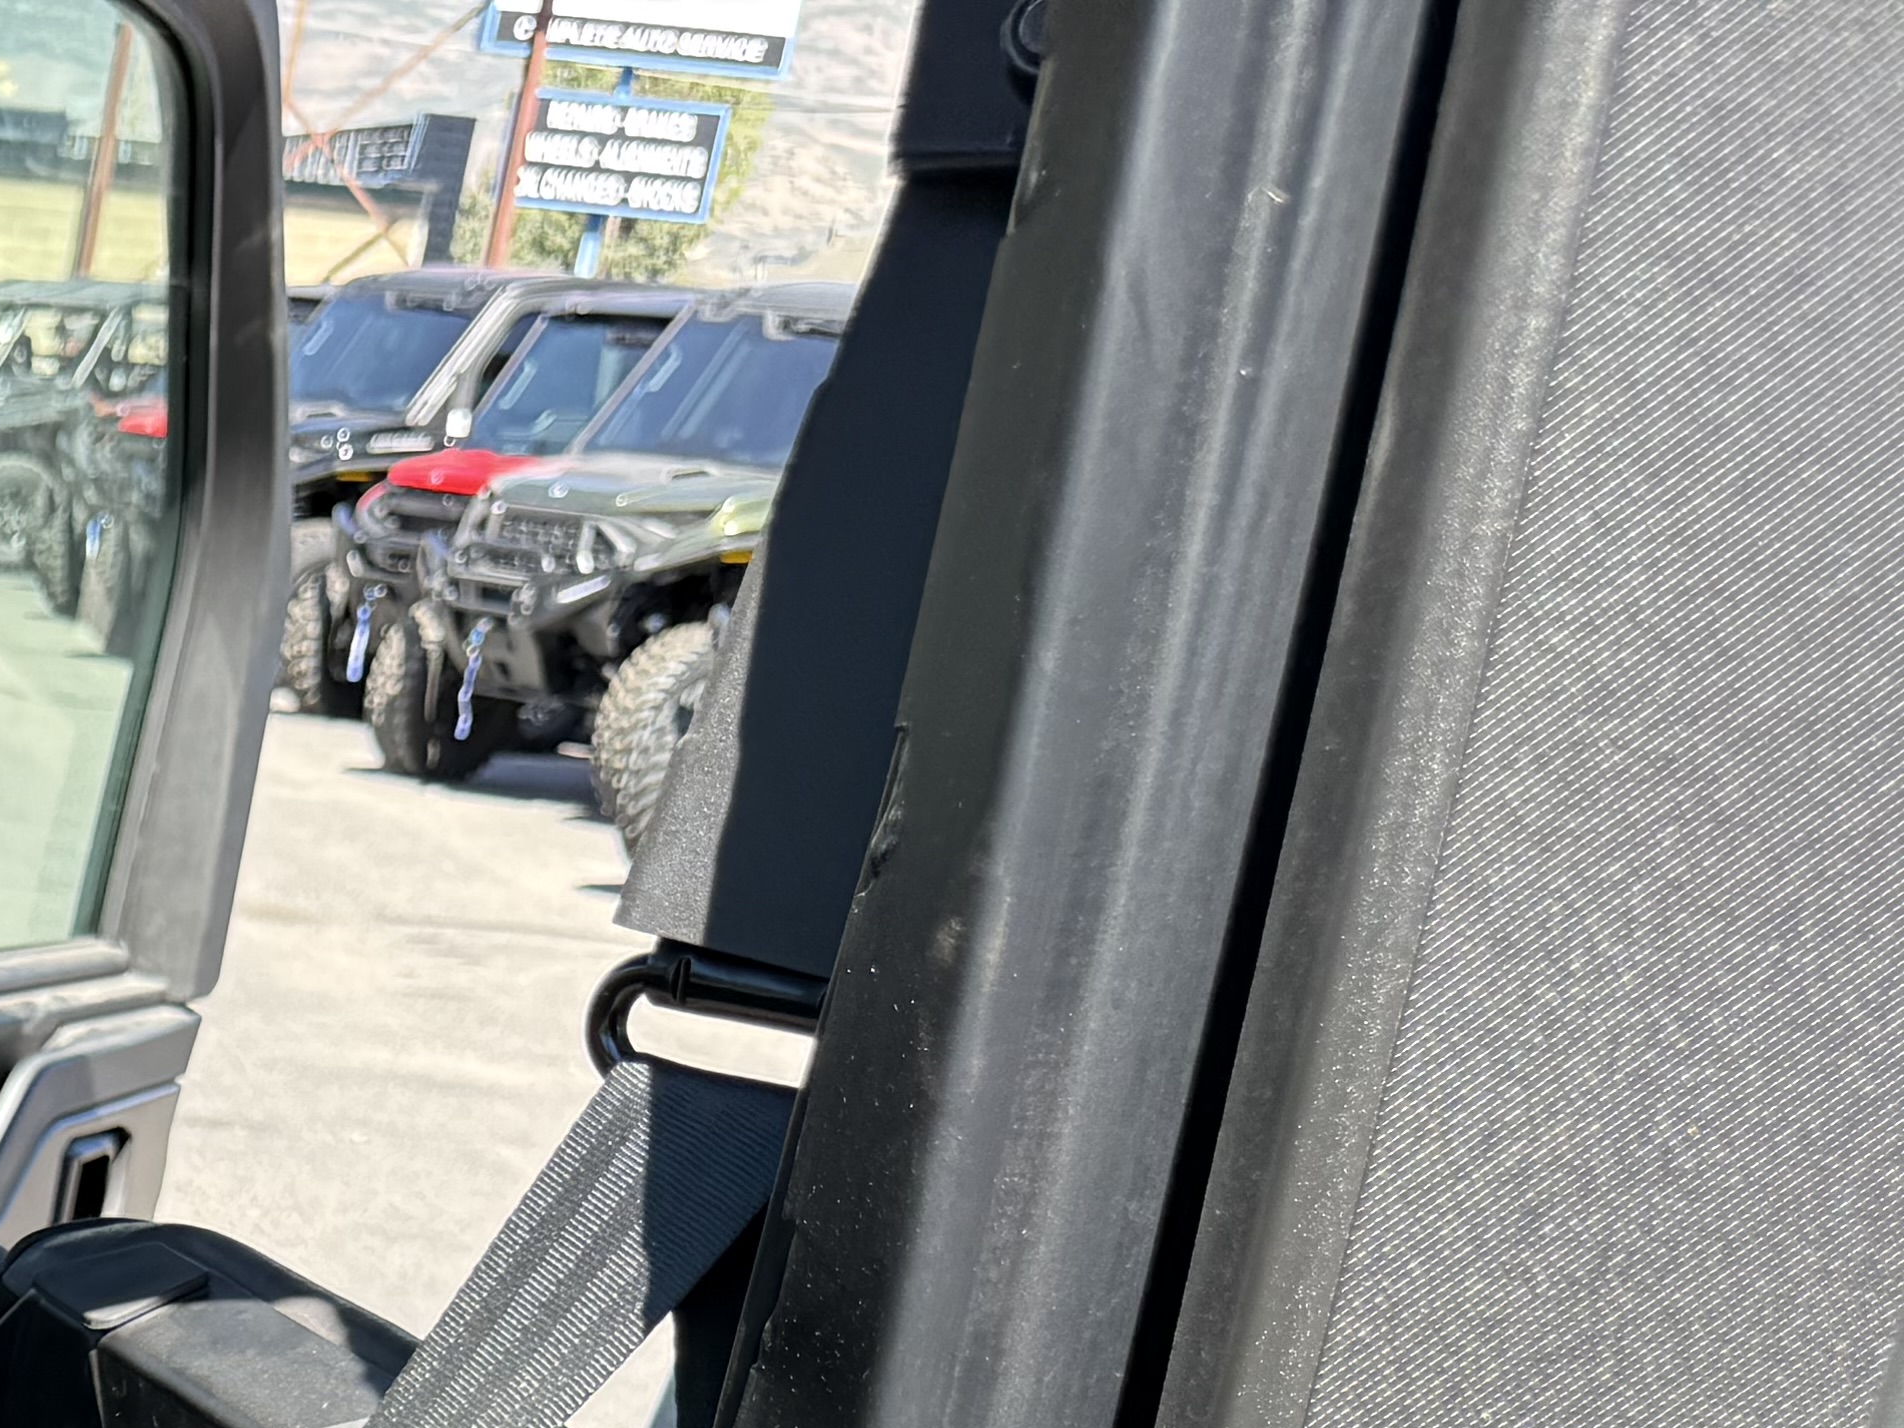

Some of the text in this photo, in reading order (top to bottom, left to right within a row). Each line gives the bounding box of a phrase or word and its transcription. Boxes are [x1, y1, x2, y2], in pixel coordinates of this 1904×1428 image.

[513, 15, 768, 63] CMPLETE AUTO SERVICE
